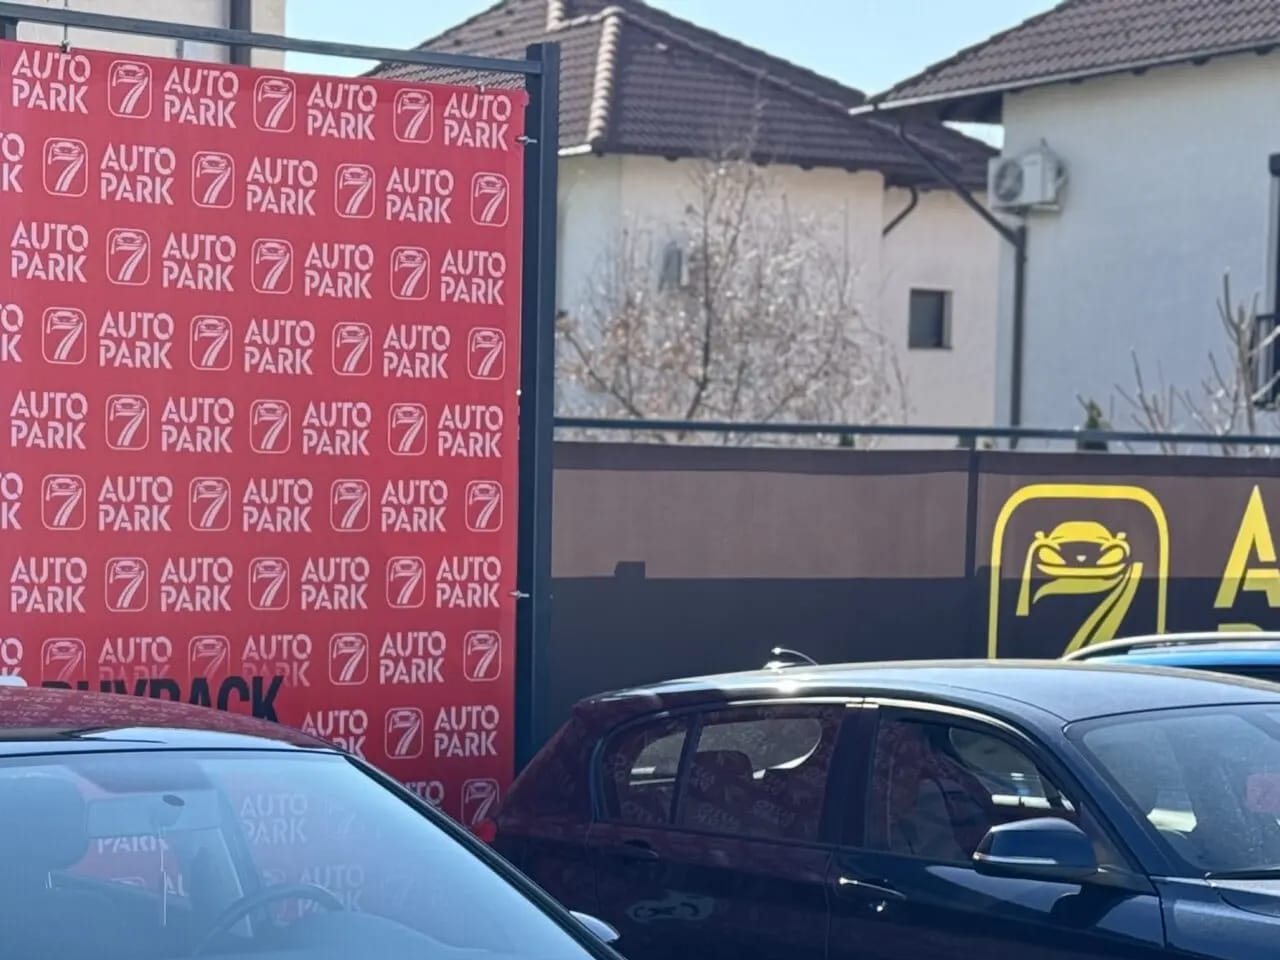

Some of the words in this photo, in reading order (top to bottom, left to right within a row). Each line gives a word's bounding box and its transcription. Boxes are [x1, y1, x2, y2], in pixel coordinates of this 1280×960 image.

[12, 50, 91, 82] AUTO
[13, 78, 88, 113] PARK
[164, 68, 238, 98] AUTO
[308, 82, 377, 111] AUTO
[165, 94, 236, 128] PARK
[444, 92, 511, 121] AUTO
[308, 109, 374, 140] PARK
[445, 119, 508, 150] PARK
[101, 144, 175, 175] AUTO
[247, 157, 317, 187] AUTO
[101, 172, 173, 205] PARK
[386, 167, 453, 195] AUTO
[247, 185, 315, 215] PARK
[386, 194, 451, 223] PARK
[11, 221, 88, 252] AUTO
[162, 233, 236, 262] AUTO
[12, 250, 86, 282] PARK
[305, 243, 373, 270] AUTO
[441, 250, 505, 277] AUTO
[163, 261, 233, 291] PARK
[305, 270, 371, 298] PARK
[441, 276, 503, 305] PARK
[99, 311, 174, 340] AUTO
[244, 319, 315, 346] AUTO
[383, 325, 450, 351] AUTO
[100, 339, 172, 368] PARK
[245, 346, 312, 374] PARK
[384, 352, 448, 378] PARK
[10, 391, 87, 420] AUTO
[161, 397, 234, 424] AUTO
[302, 402, 371, 428] AUTO
[438, 405, 503, 430] AUTO
[11, 420, 85, 449] PARK
[162, 425, 232, 452] PARK
[303, 429, 369, 455] PARK
[439, 431, 501, 457] PARK
[98, 476, 172, 502] AUTO
[243, 479, 313, 504] AUTO
[381, 480, 448, 505] AUTO
[99, 504, 171, 531] PARK
[243, 506, 311, 532] PARK
[382, 507, 446, 532] PARK
[10, 557, 87, 584] AUTO
[160, 557, 233, 583] AUTO
[301, 557, 369, 582] AUTO
[436, 556, 501, 581] AUTO
[11, 586, 85, 612] PARK
[161, 585, 231, 611] PARK
[302, 584, 367, 610] PARK
[437, 583, 499, 608] PARK
[99, 636, 172, 663] AUTO
[242, 634, 312, 660] AUTO
[380, 631, 446, 657] AUTO
[380, 658, 444, 684] PARK
[301, 709, 368, 736] AUTO
[434, 705, 499, 730] AUTO
[435, 731, 496, 757] PARK
